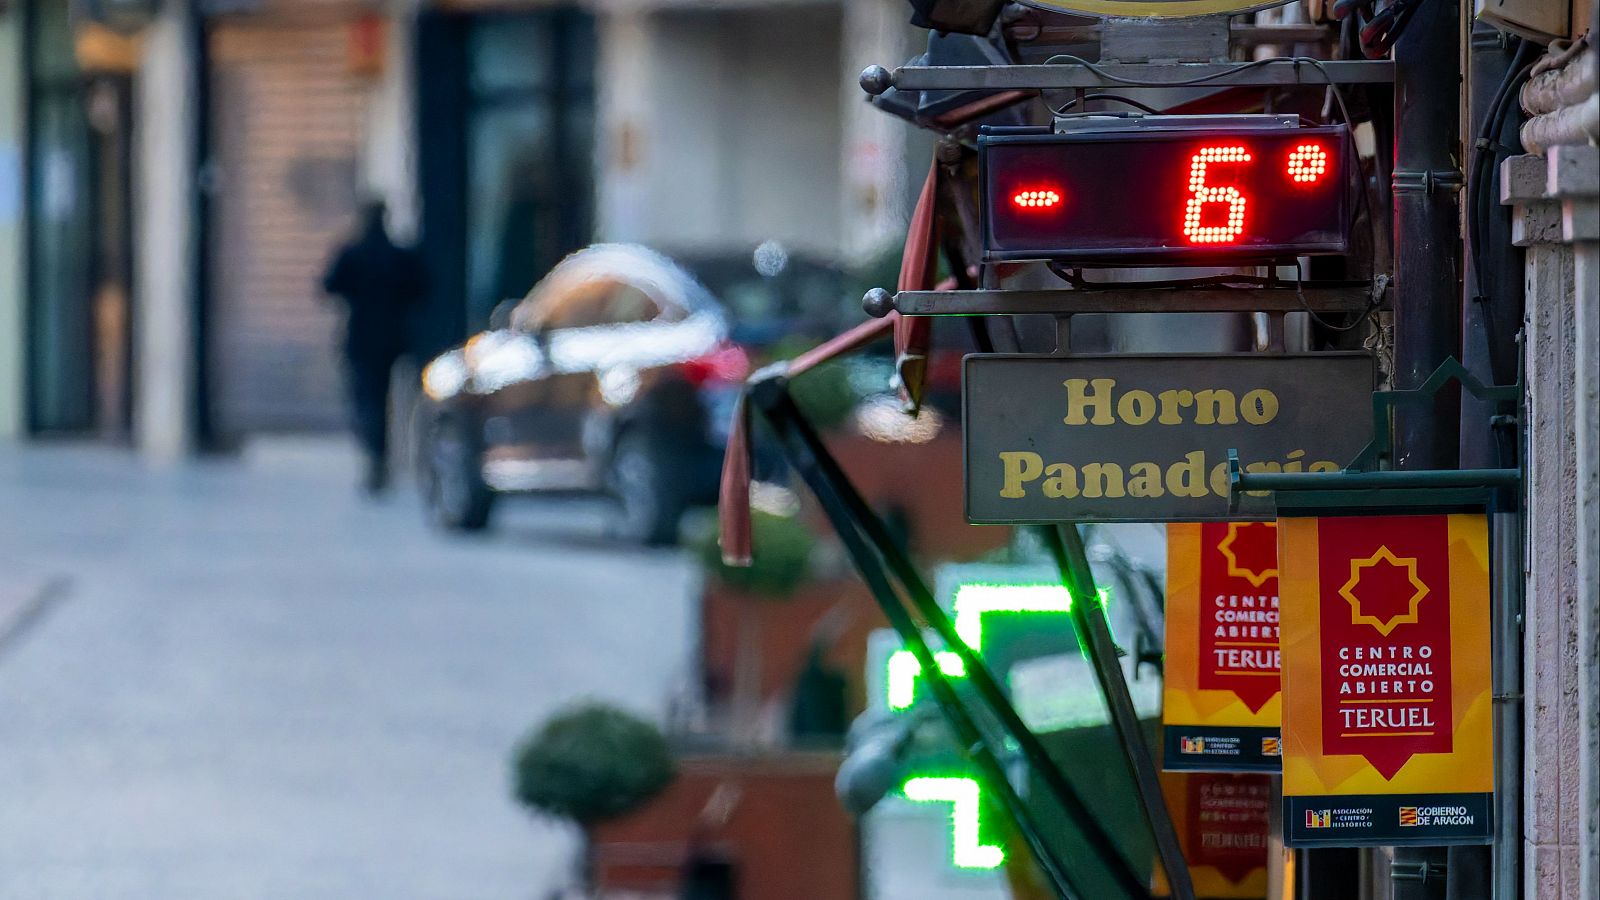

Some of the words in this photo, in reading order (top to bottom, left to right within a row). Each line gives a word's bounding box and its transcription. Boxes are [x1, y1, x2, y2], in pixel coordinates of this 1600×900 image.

[1063, 378, 1279, 426] Horno
[1215, 594, 1280, 608] CENTR
[1214, 609, 1280, 623] COMERCI
[1214, 625, 1280, 638] ABIERT
[1213, 648, 1281, 669] TERUE
[1339, 645, 1432, 660] CENTRO
[1339, 663, 1433, 677] COMERCIAL
[1339, 680, 1434, 694] ABIERTO
[1339, 707, 1435, 728] TERUEL
[1417, 806, 1467, 816] GOBIERNO
[1417, 816, 1431, 826] DE
